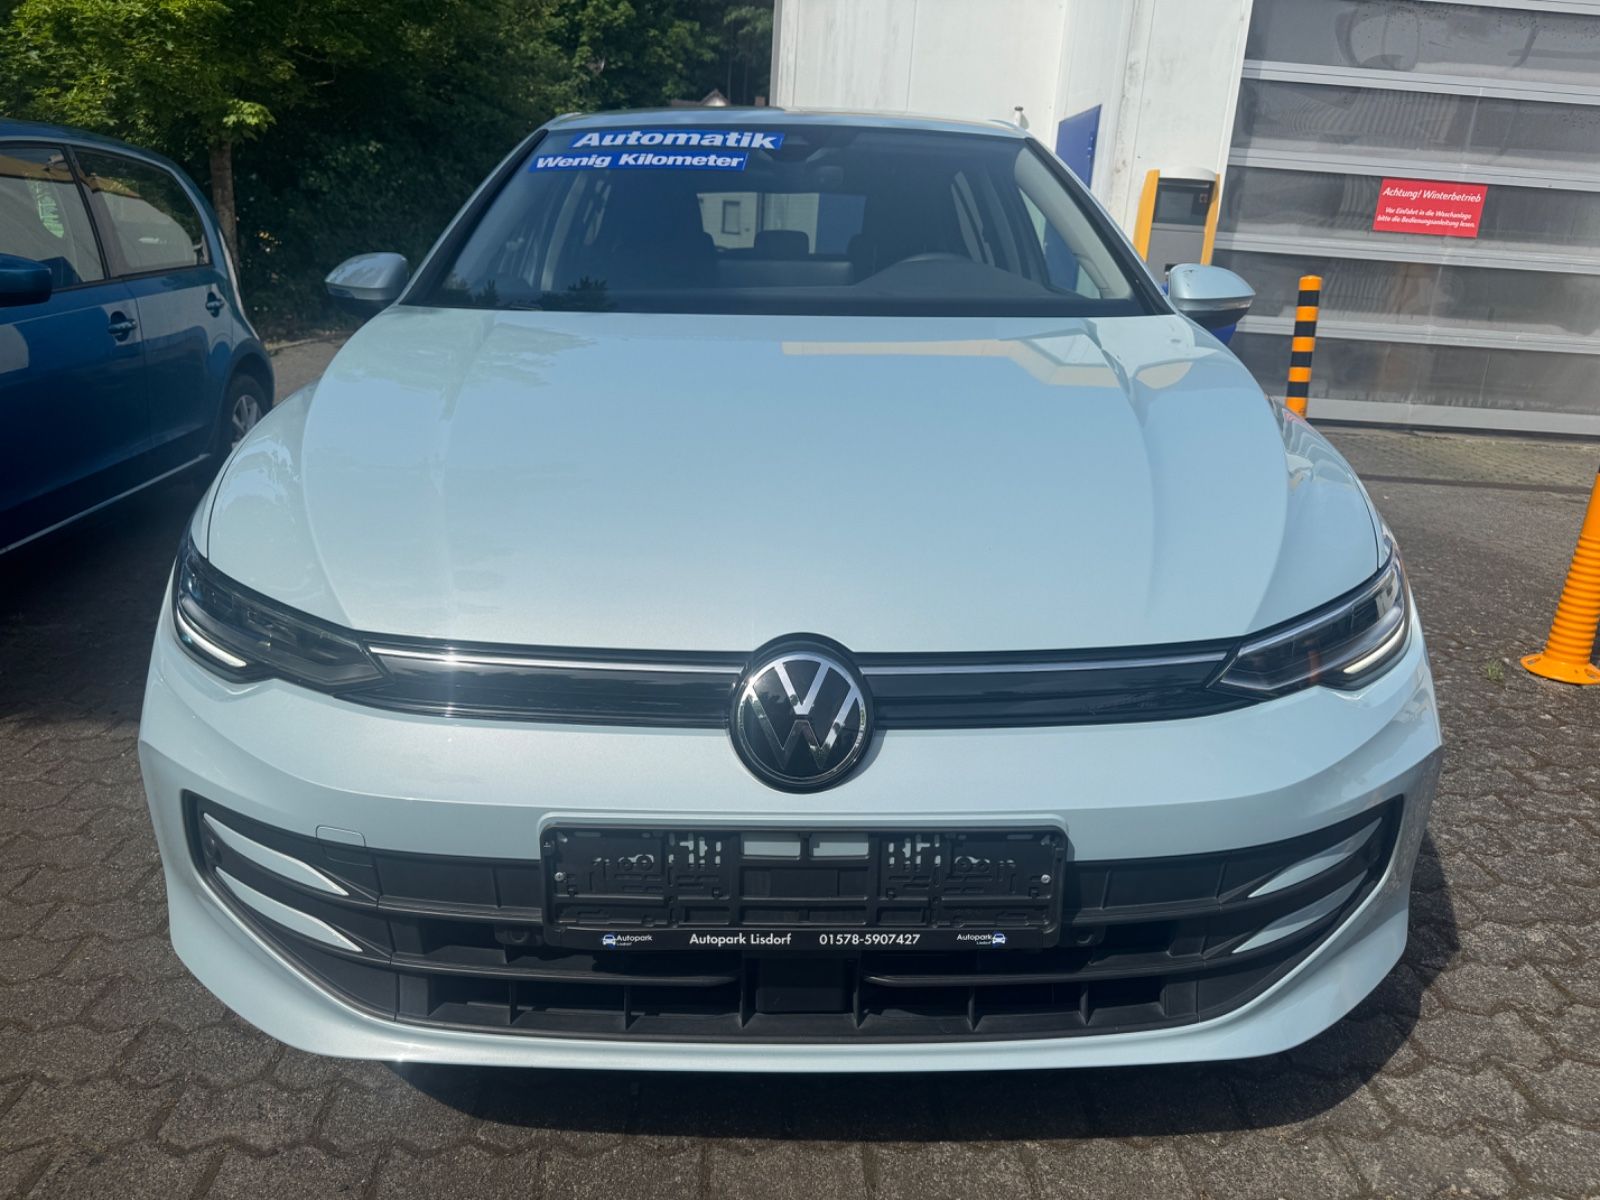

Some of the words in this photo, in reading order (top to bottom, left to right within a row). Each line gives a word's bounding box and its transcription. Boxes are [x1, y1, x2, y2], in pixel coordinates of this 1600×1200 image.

[572, 130, 778, 150] Automatik
[536, 154, 613, 168] Wenig
[618, 153, 744, 168] Kilometer
[1382, 187, 1422, 200] Achtung!
[1423, 190, 1481, 203] Winterbetrieb
[616, 935, 653, 943] Autopark
[689, 932, 746, 947] Autopark
[750, 932, 792, 945] Lisdorf
[819, 933, 920, 945] 01578-5907427
[956, 933, 992, 941] Autopark
